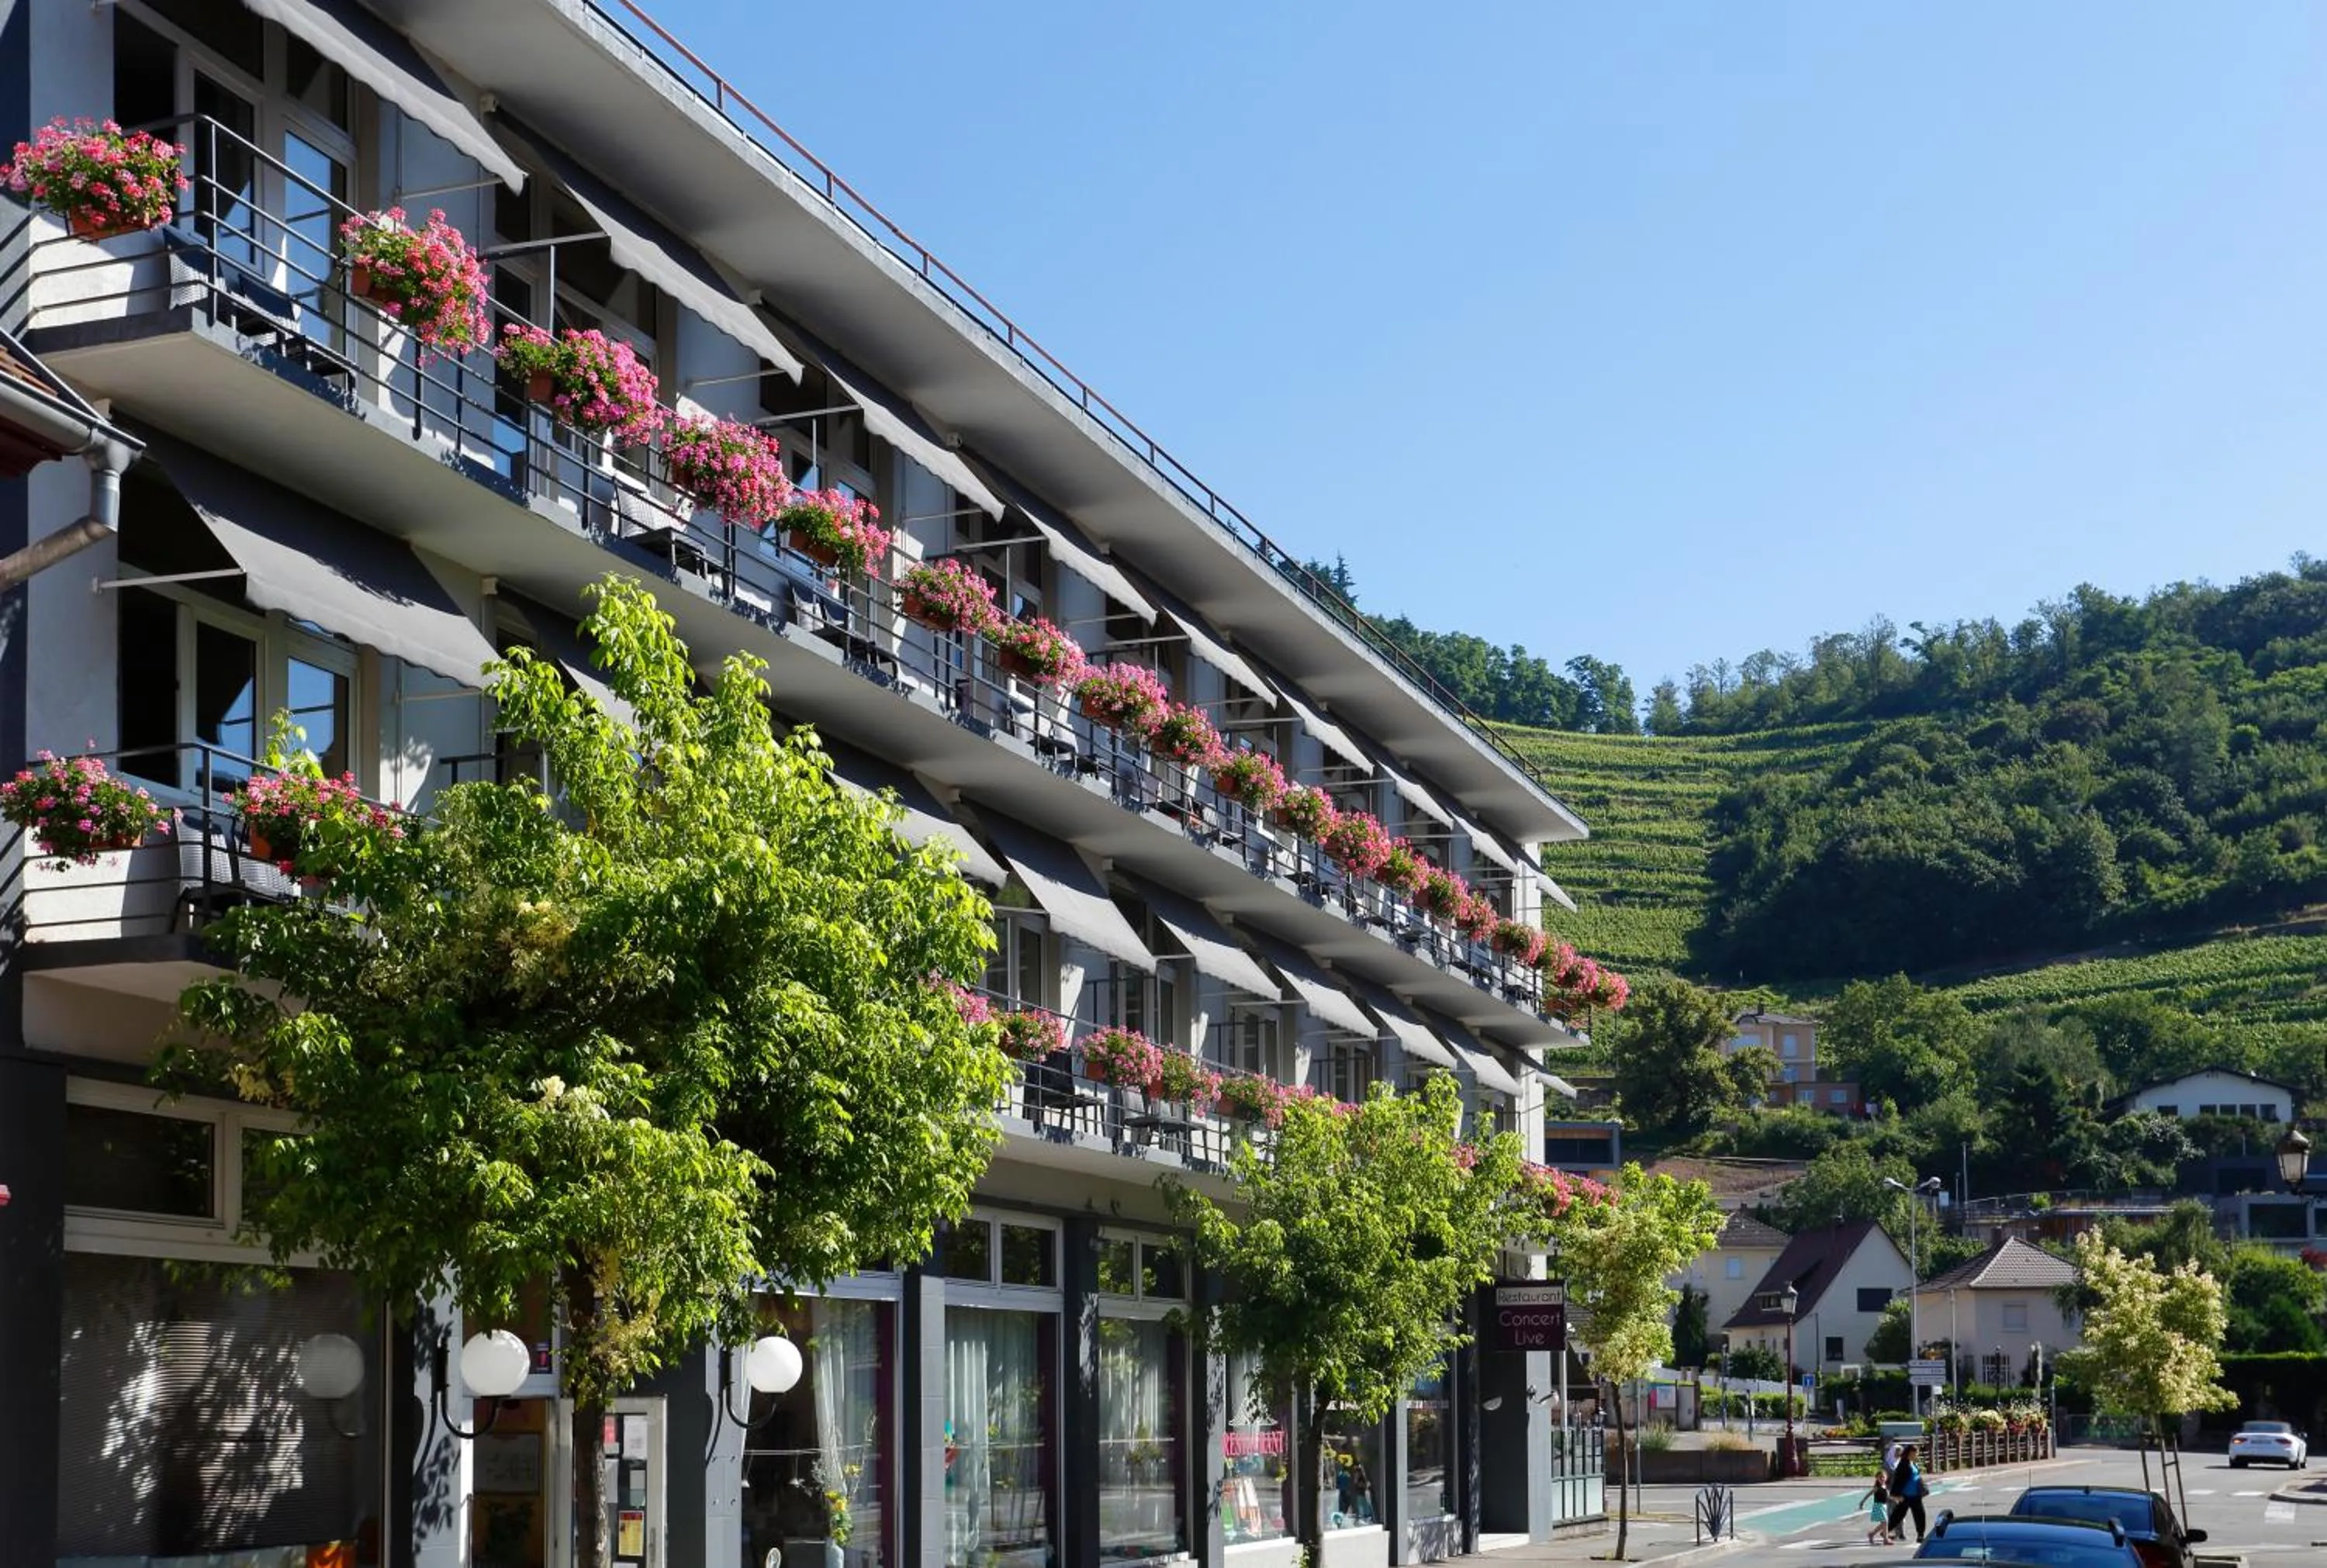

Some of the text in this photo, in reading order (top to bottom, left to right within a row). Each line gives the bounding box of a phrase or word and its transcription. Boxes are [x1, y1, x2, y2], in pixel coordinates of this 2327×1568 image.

[1498, 1290, 1561, 1303] Restaurant
[1499, 1311, 1561, 1327] Concert
[1515, 1330, 1544, 1346] Live
